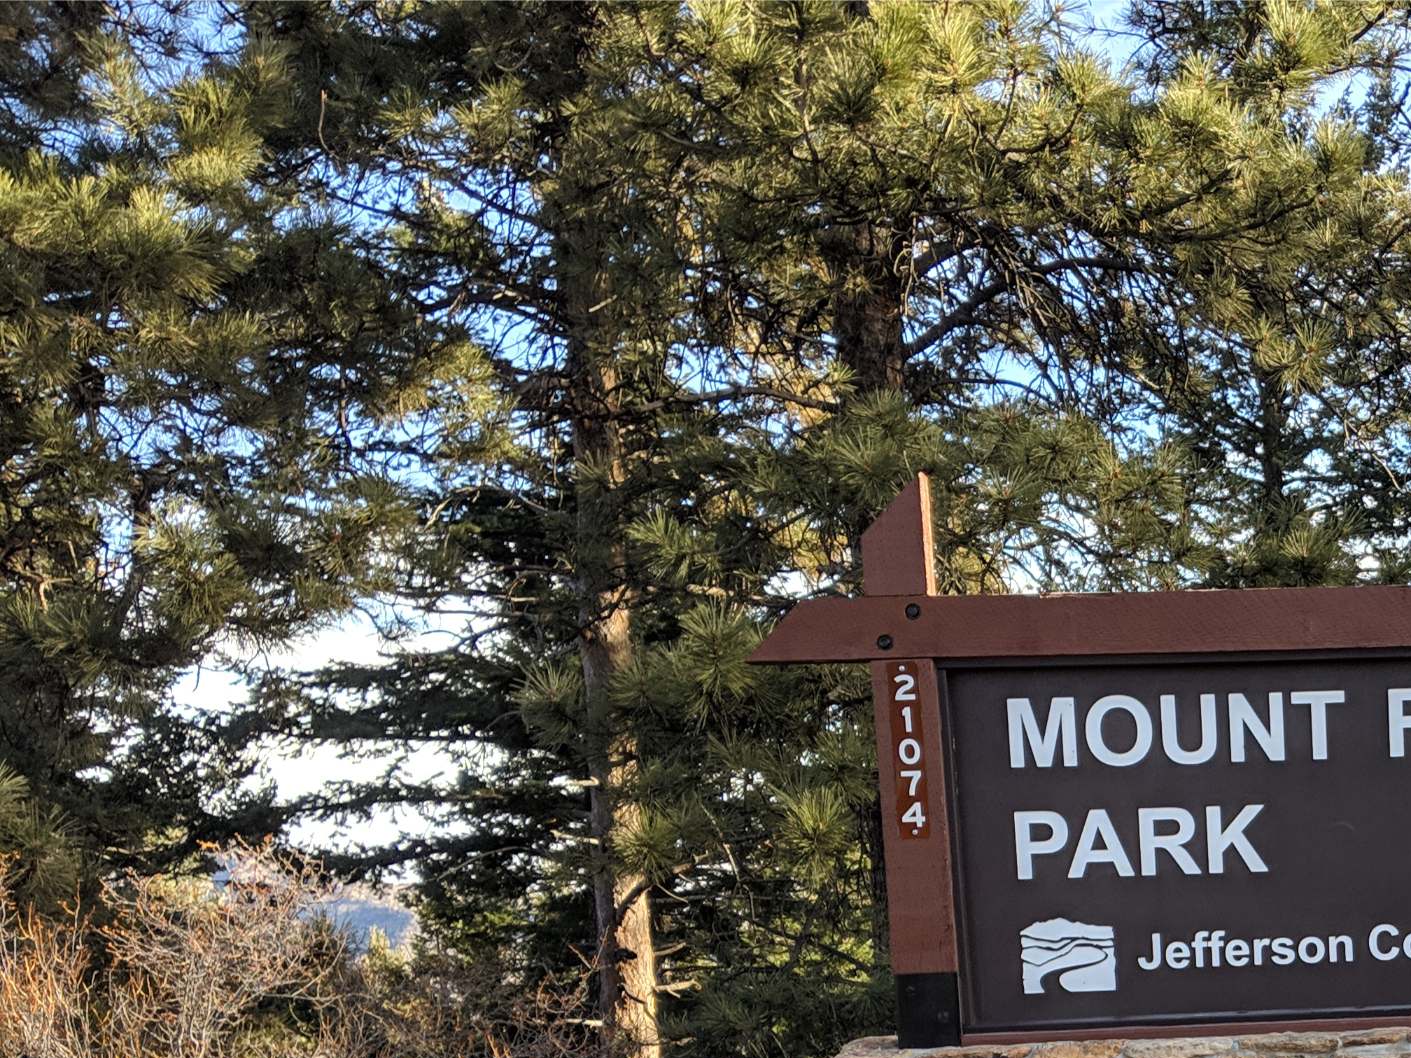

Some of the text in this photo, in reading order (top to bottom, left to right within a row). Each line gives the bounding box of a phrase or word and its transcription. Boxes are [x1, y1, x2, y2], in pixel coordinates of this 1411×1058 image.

[893, 673, 926, 828] 21074
[1006, 689, 1346, 769] MOUNT
[1013, 804, 1269, 880] PARK
[1137, 930, 1354, 971] Jefferson
